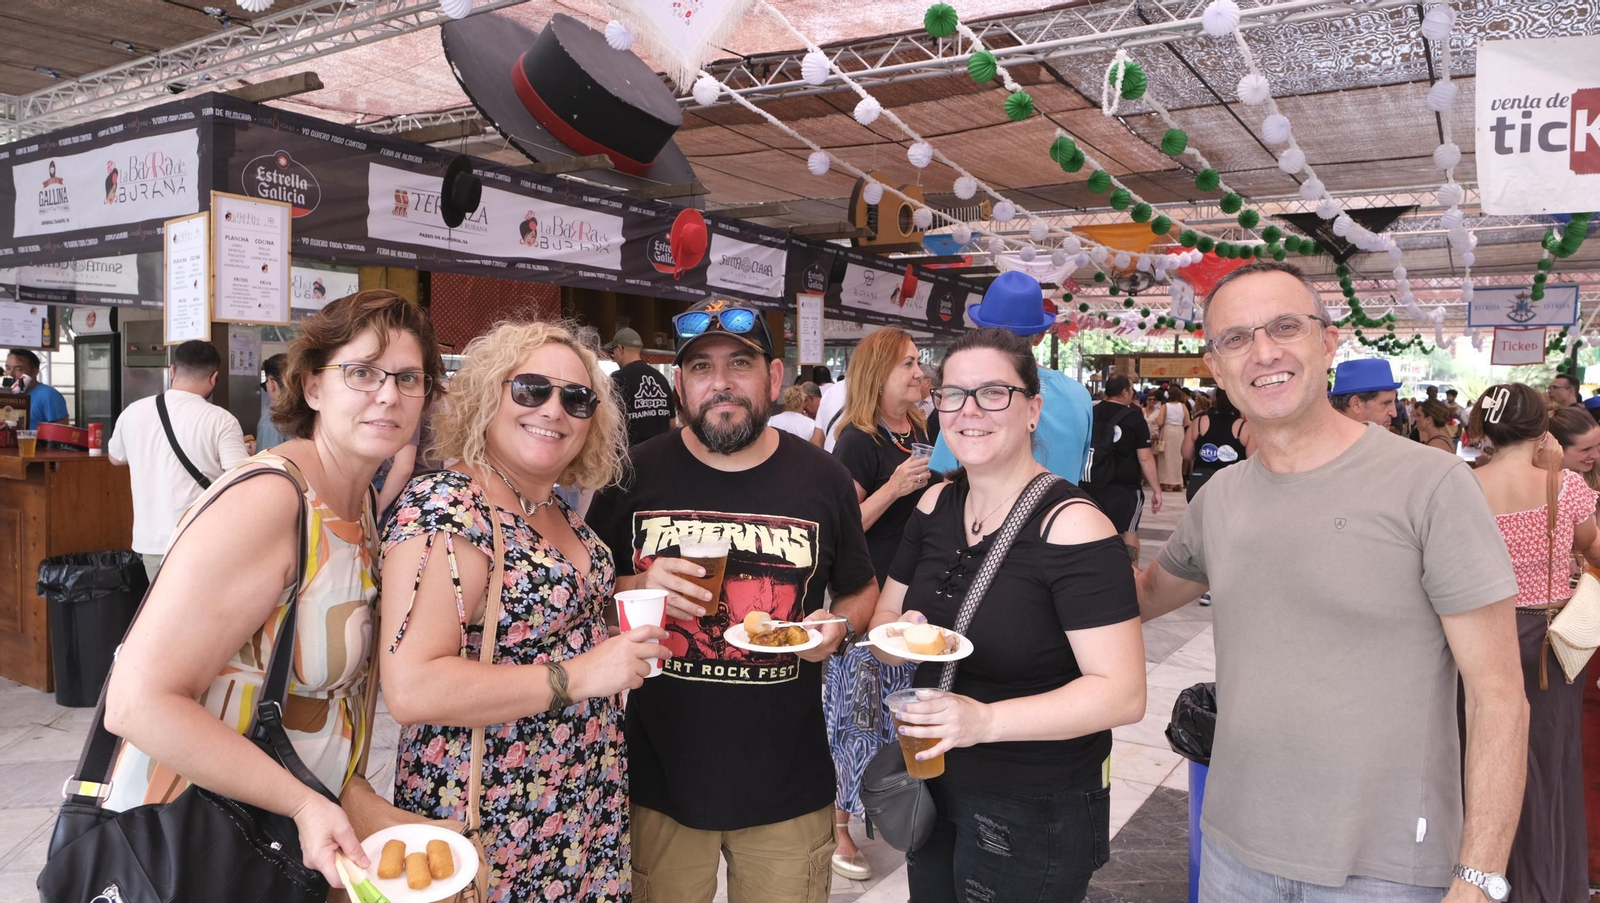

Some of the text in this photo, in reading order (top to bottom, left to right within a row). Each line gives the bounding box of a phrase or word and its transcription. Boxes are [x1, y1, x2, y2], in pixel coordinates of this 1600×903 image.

[1491, 93, 1569, 111] venta de
[202, 108, 214, 117] FERIA
[215, 108, 224, 117] DE
[225, 110, 252, 122] ALMERIA
[302, 127, 310, 136] YO
[310, 129, 331, 141] QUIERO
[331, 134, 345, 145] TODO
[345, 138, 368, 150] CONTIGO
[380, 148, 394, 158] FERIA
[402, 153, 423, 164] ALMERIA
[256, 165, 308, 191] Estrella
[39, 187, 69, 207] GALLINA
[119, 177, 186, 204] BURANA
[258, 182, 306, 205] Galicia
[465, 223, 488, 233] BURANA
[225, 235, 249, 243] PLANCHA
[301, 237, 309, 245] YO
[390, 249, 397, 258] DE
[635, 399, 667, 409] Kappa
[639, 516, 813, 568] TABERNAS
[665, 660, 795, 679] ERT ROCK FEST
